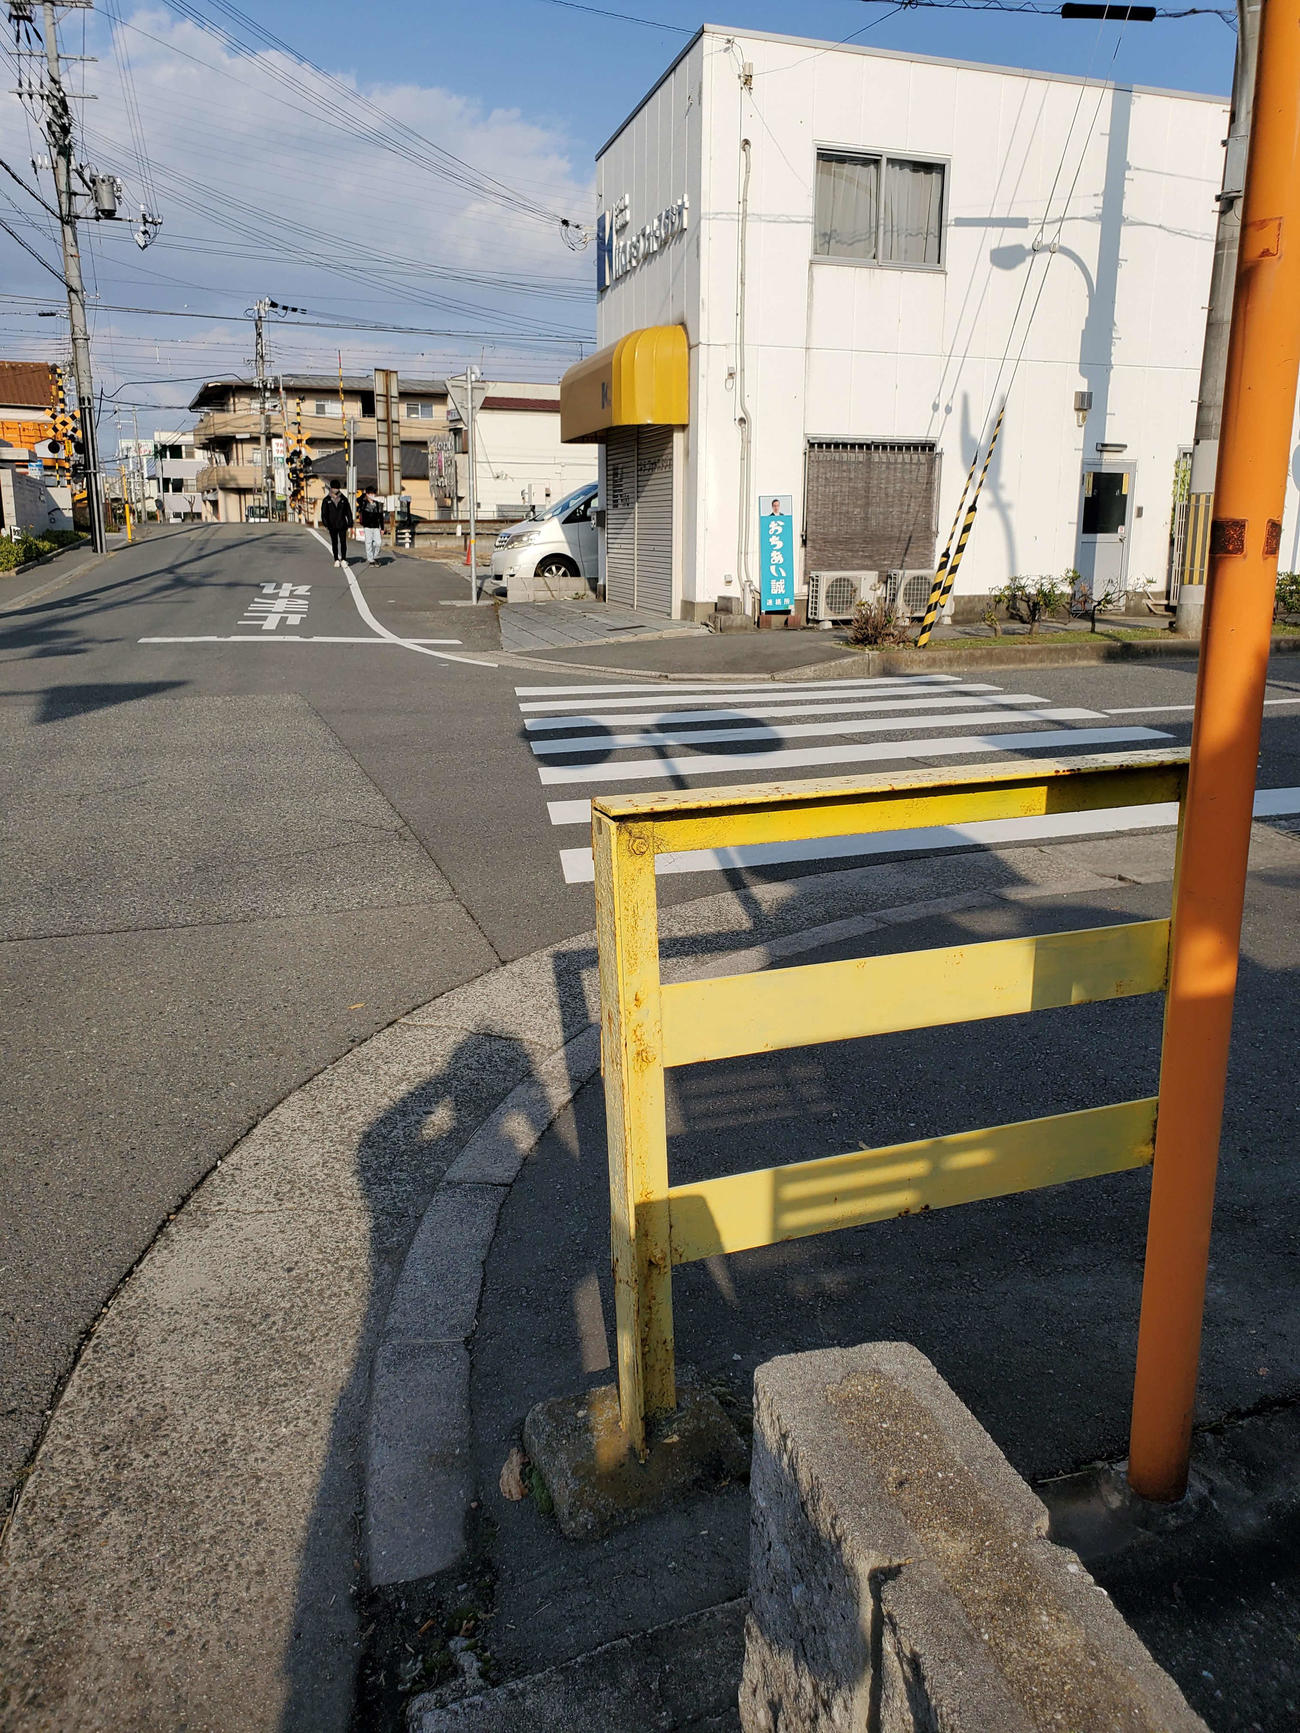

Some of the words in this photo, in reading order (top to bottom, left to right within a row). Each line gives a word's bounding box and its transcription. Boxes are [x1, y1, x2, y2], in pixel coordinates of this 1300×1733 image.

[768, 520, 787, 595] おちあい誠
[237, 583, 313, 630] 止まれ
